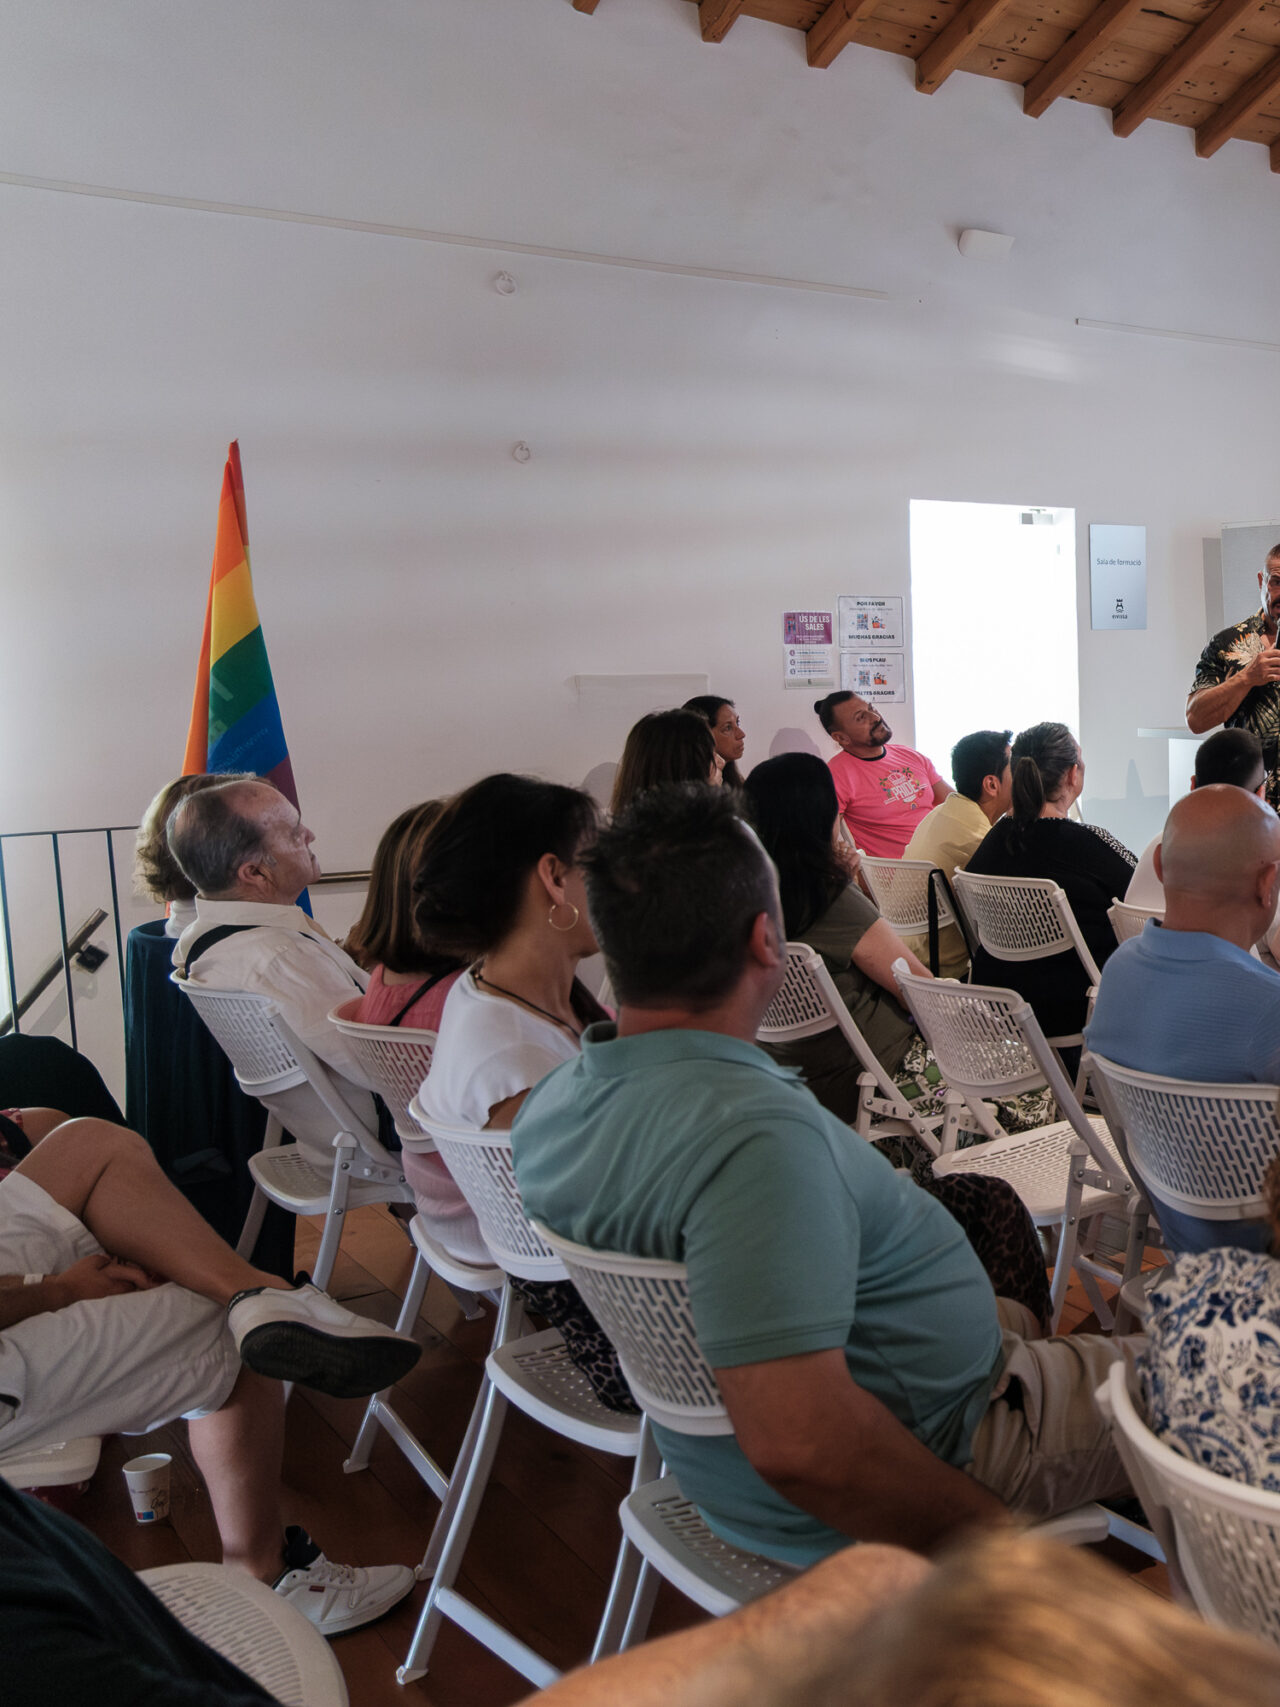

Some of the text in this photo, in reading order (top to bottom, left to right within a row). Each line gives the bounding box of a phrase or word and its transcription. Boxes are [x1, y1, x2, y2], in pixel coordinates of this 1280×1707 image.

[1096, 558, 1142, 566] Sala de formació
[809, 615, 818, 623] DE
[818, 615, 830, 623] LES
[805, 623, 825, 631] SALES
[891, 779, 919, 801] PRIDE
